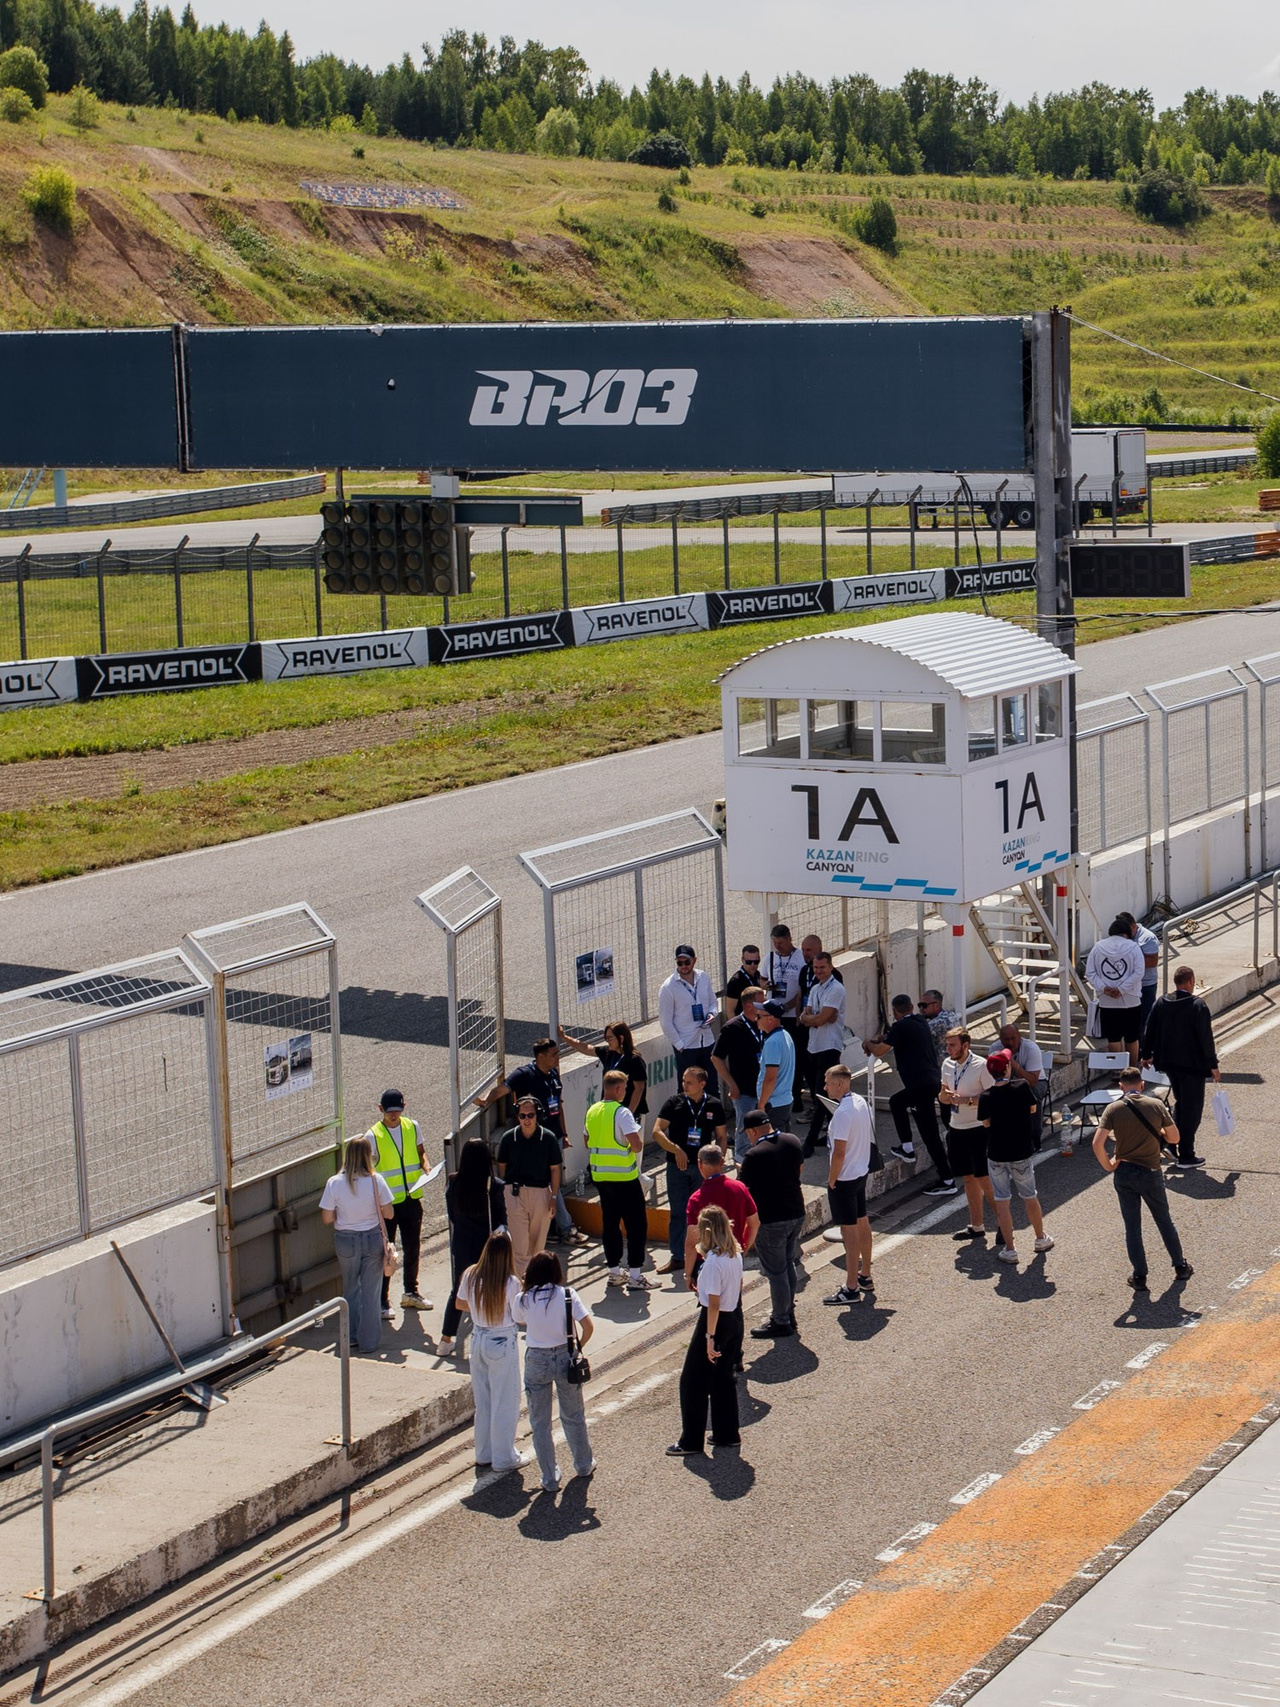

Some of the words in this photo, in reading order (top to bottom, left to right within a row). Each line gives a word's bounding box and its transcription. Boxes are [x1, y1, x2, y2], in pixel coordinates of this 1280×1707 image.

[854, 580, 928, 600] RAVENOL
[730, 592, 815, 614] RAVENOL
[597, 606, 687, 631] RAVENOL
[454, 624, 552, 651] RAVENOL
[293, 642, 402, 668] RAVENOL
[108, 657, 234, 685] RAVENOL
[0, 672, 43, 694] OL
[806, 861, 854, 873] CANYON
